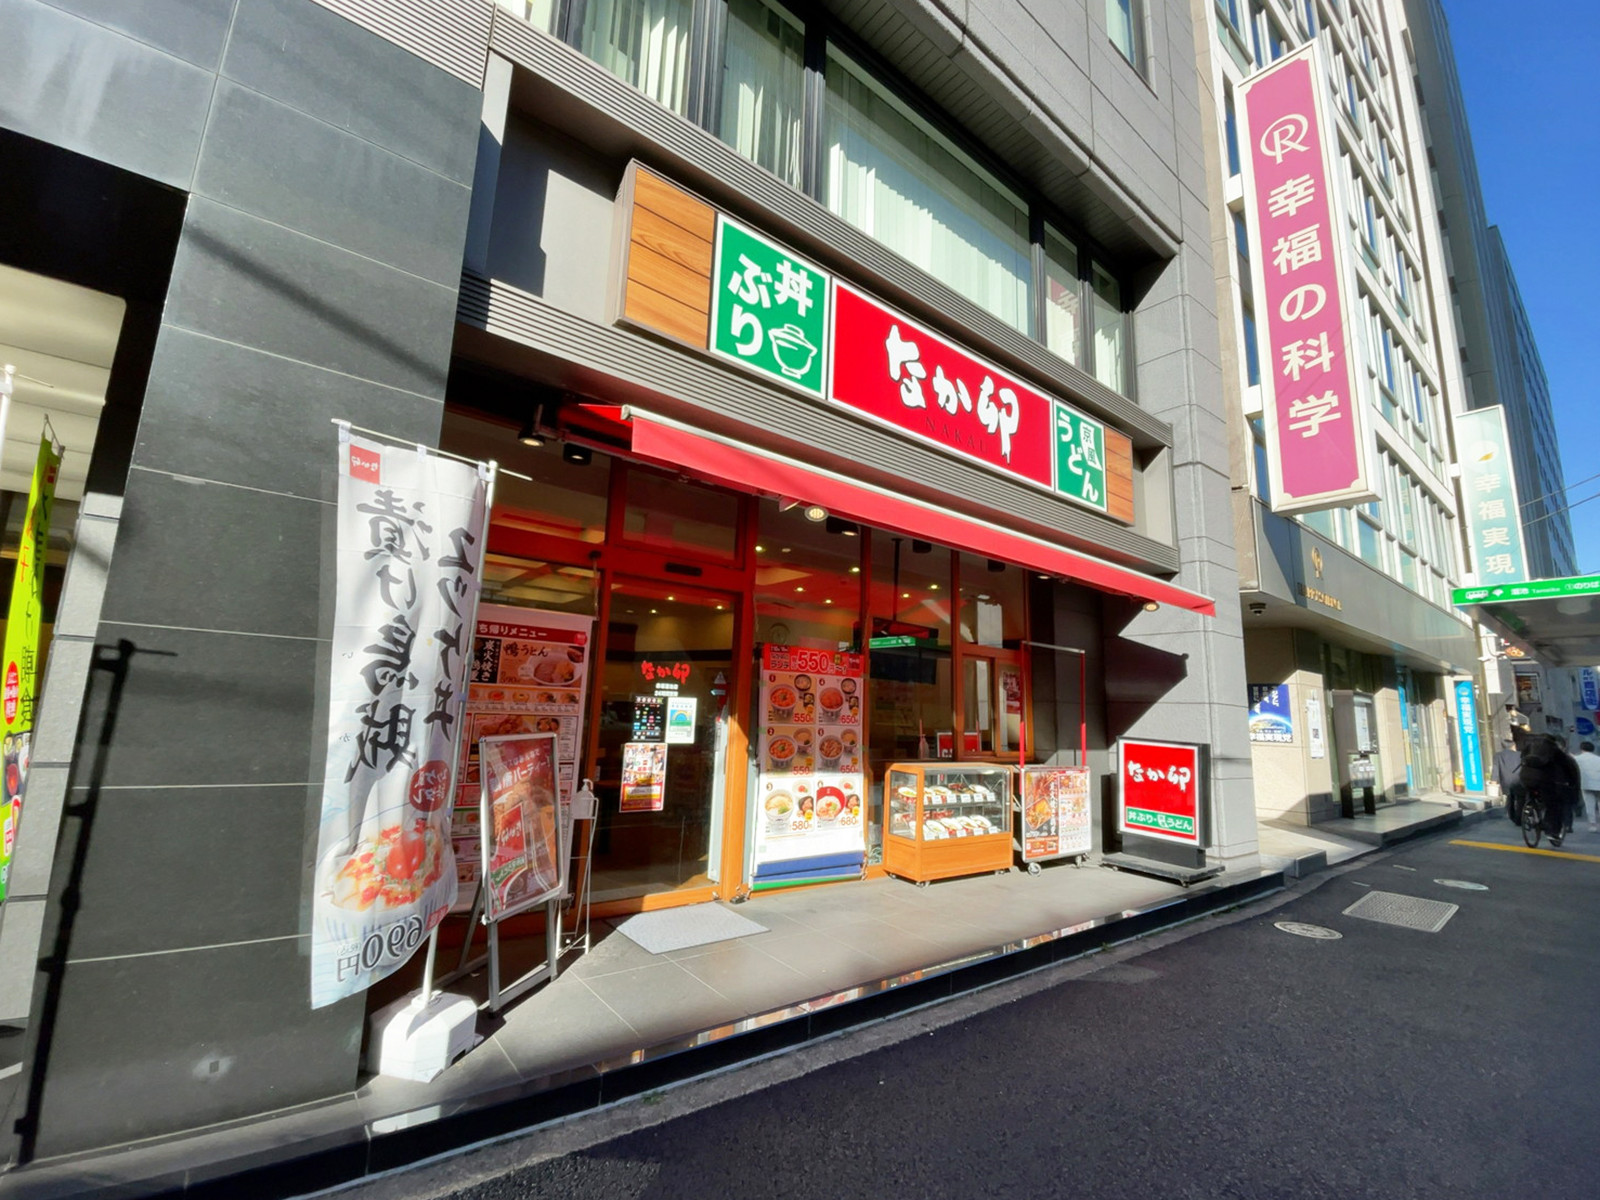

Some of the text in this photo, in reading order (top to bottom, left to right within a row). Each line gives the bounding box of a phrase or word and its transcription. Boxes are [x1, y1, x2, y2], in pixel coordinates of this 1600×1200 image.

[1268, 174, 1341, 438] 幸福の科学
[885, 324, 1020, 465] なか卯
[1058, 411, 1099, 502] うどん
[641, 660, 691, 684] なか卯
[1127, 760, 1191, 792] なか卯
